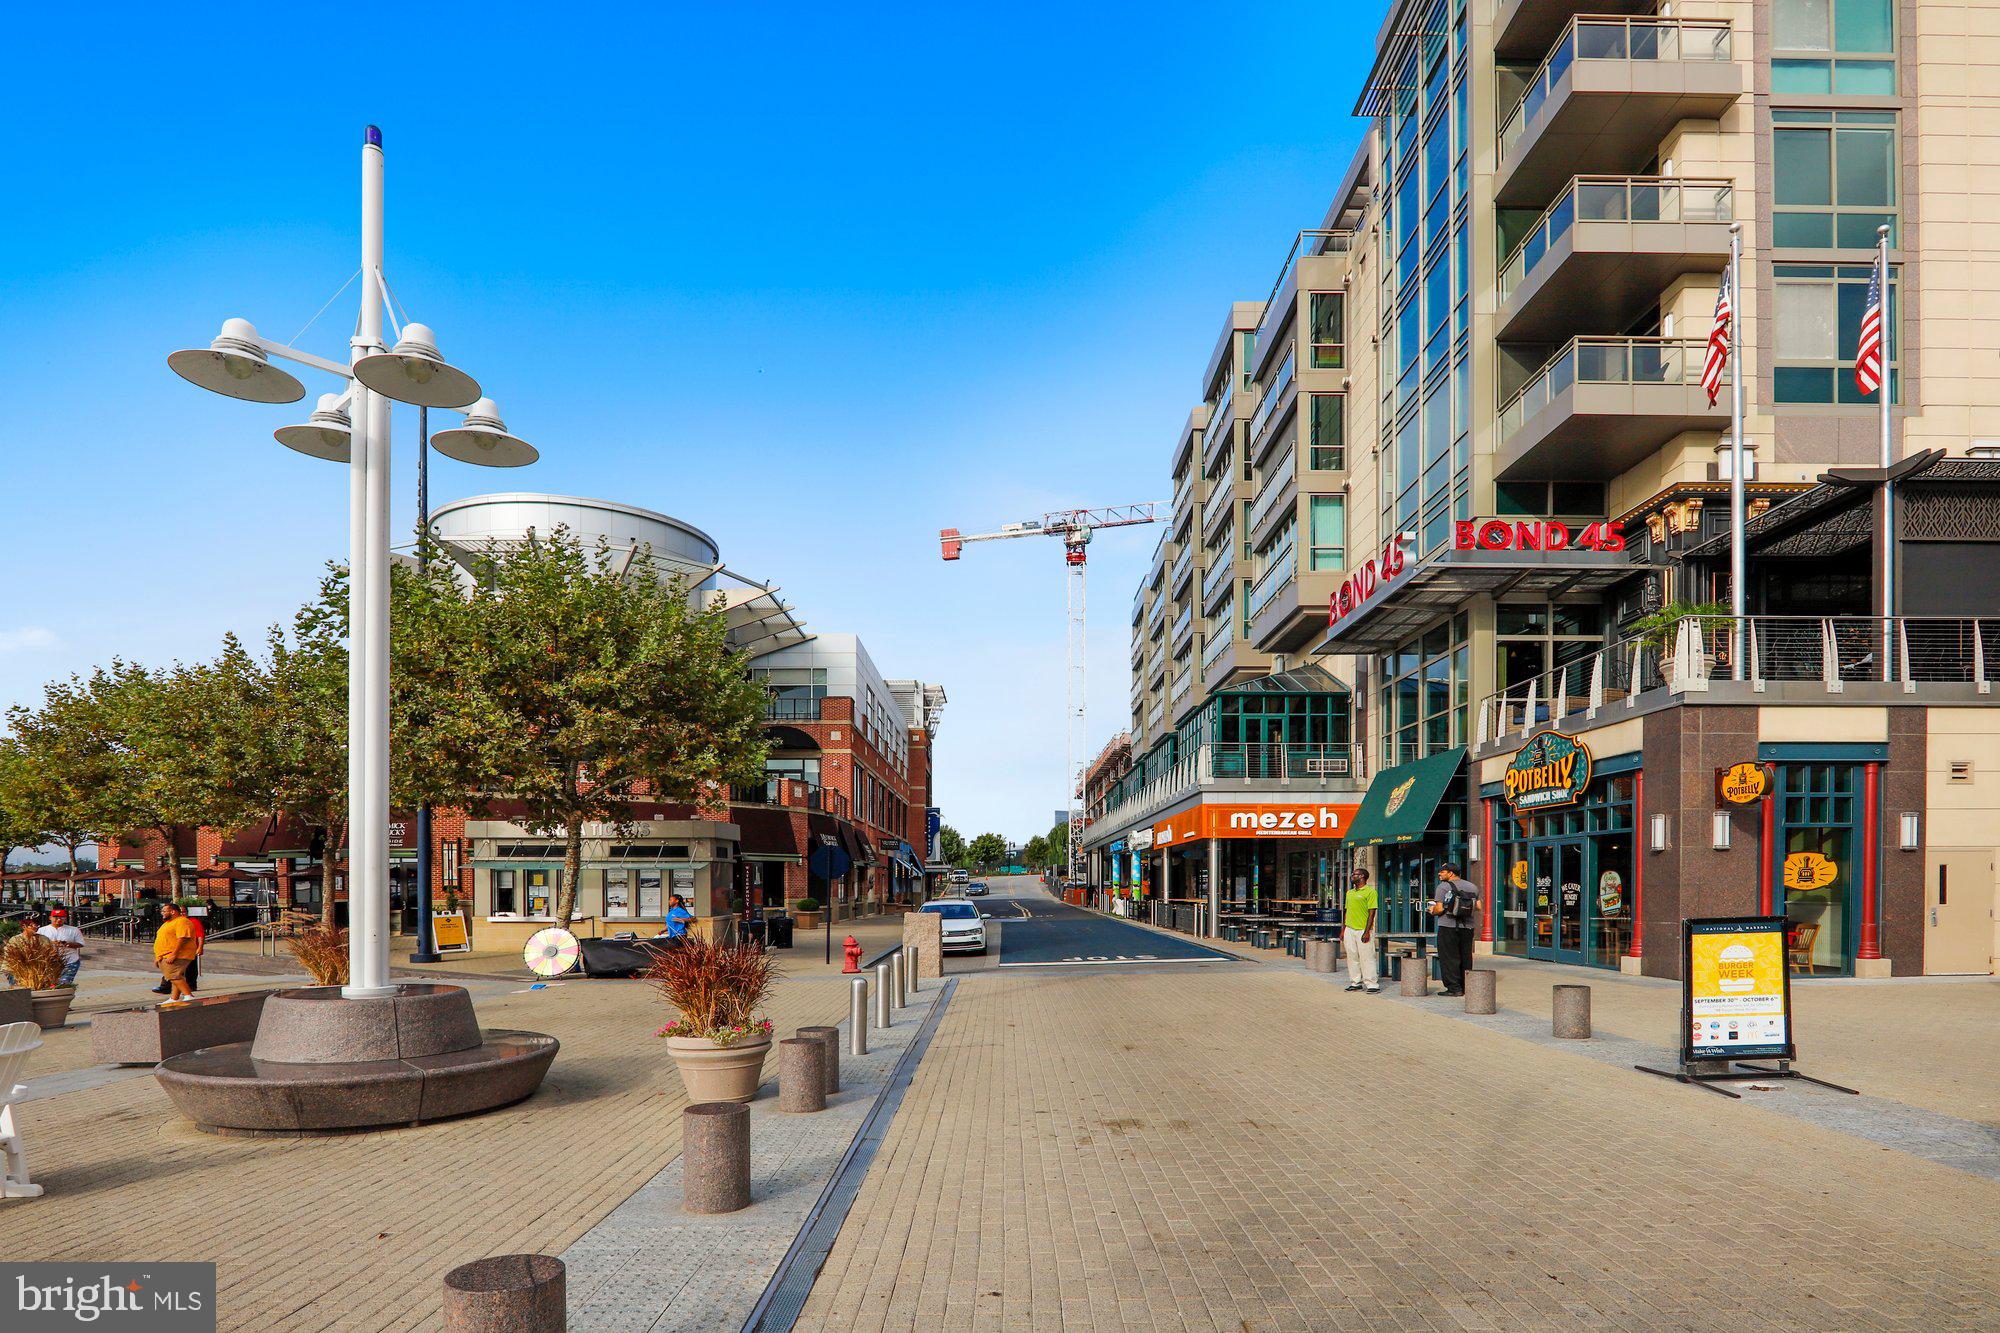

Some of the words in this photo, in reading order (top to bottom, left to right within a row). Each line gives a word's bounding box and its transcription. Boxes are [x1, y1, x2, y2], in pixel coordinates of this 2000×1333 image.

[1455, 519, 1569, 551] BOND
[1575, 521, 1626, 552] 45
[1329, 559, 1376, 628] BOND
[1380, 533, 1411, 583] 45
[1505, 751, 1576, 799] POTBELLY
[1519, 791, 1551, 804] SANDWICH
[1551, 789, 1569, 799] SHOP
[1727, 781, 1760, 798] POTBELLY
[1230, 806, 1338, 829] mezeh
[1718, 962, 1754, 970] BURGER
[1718, 969, 1754, 979] WEEK
